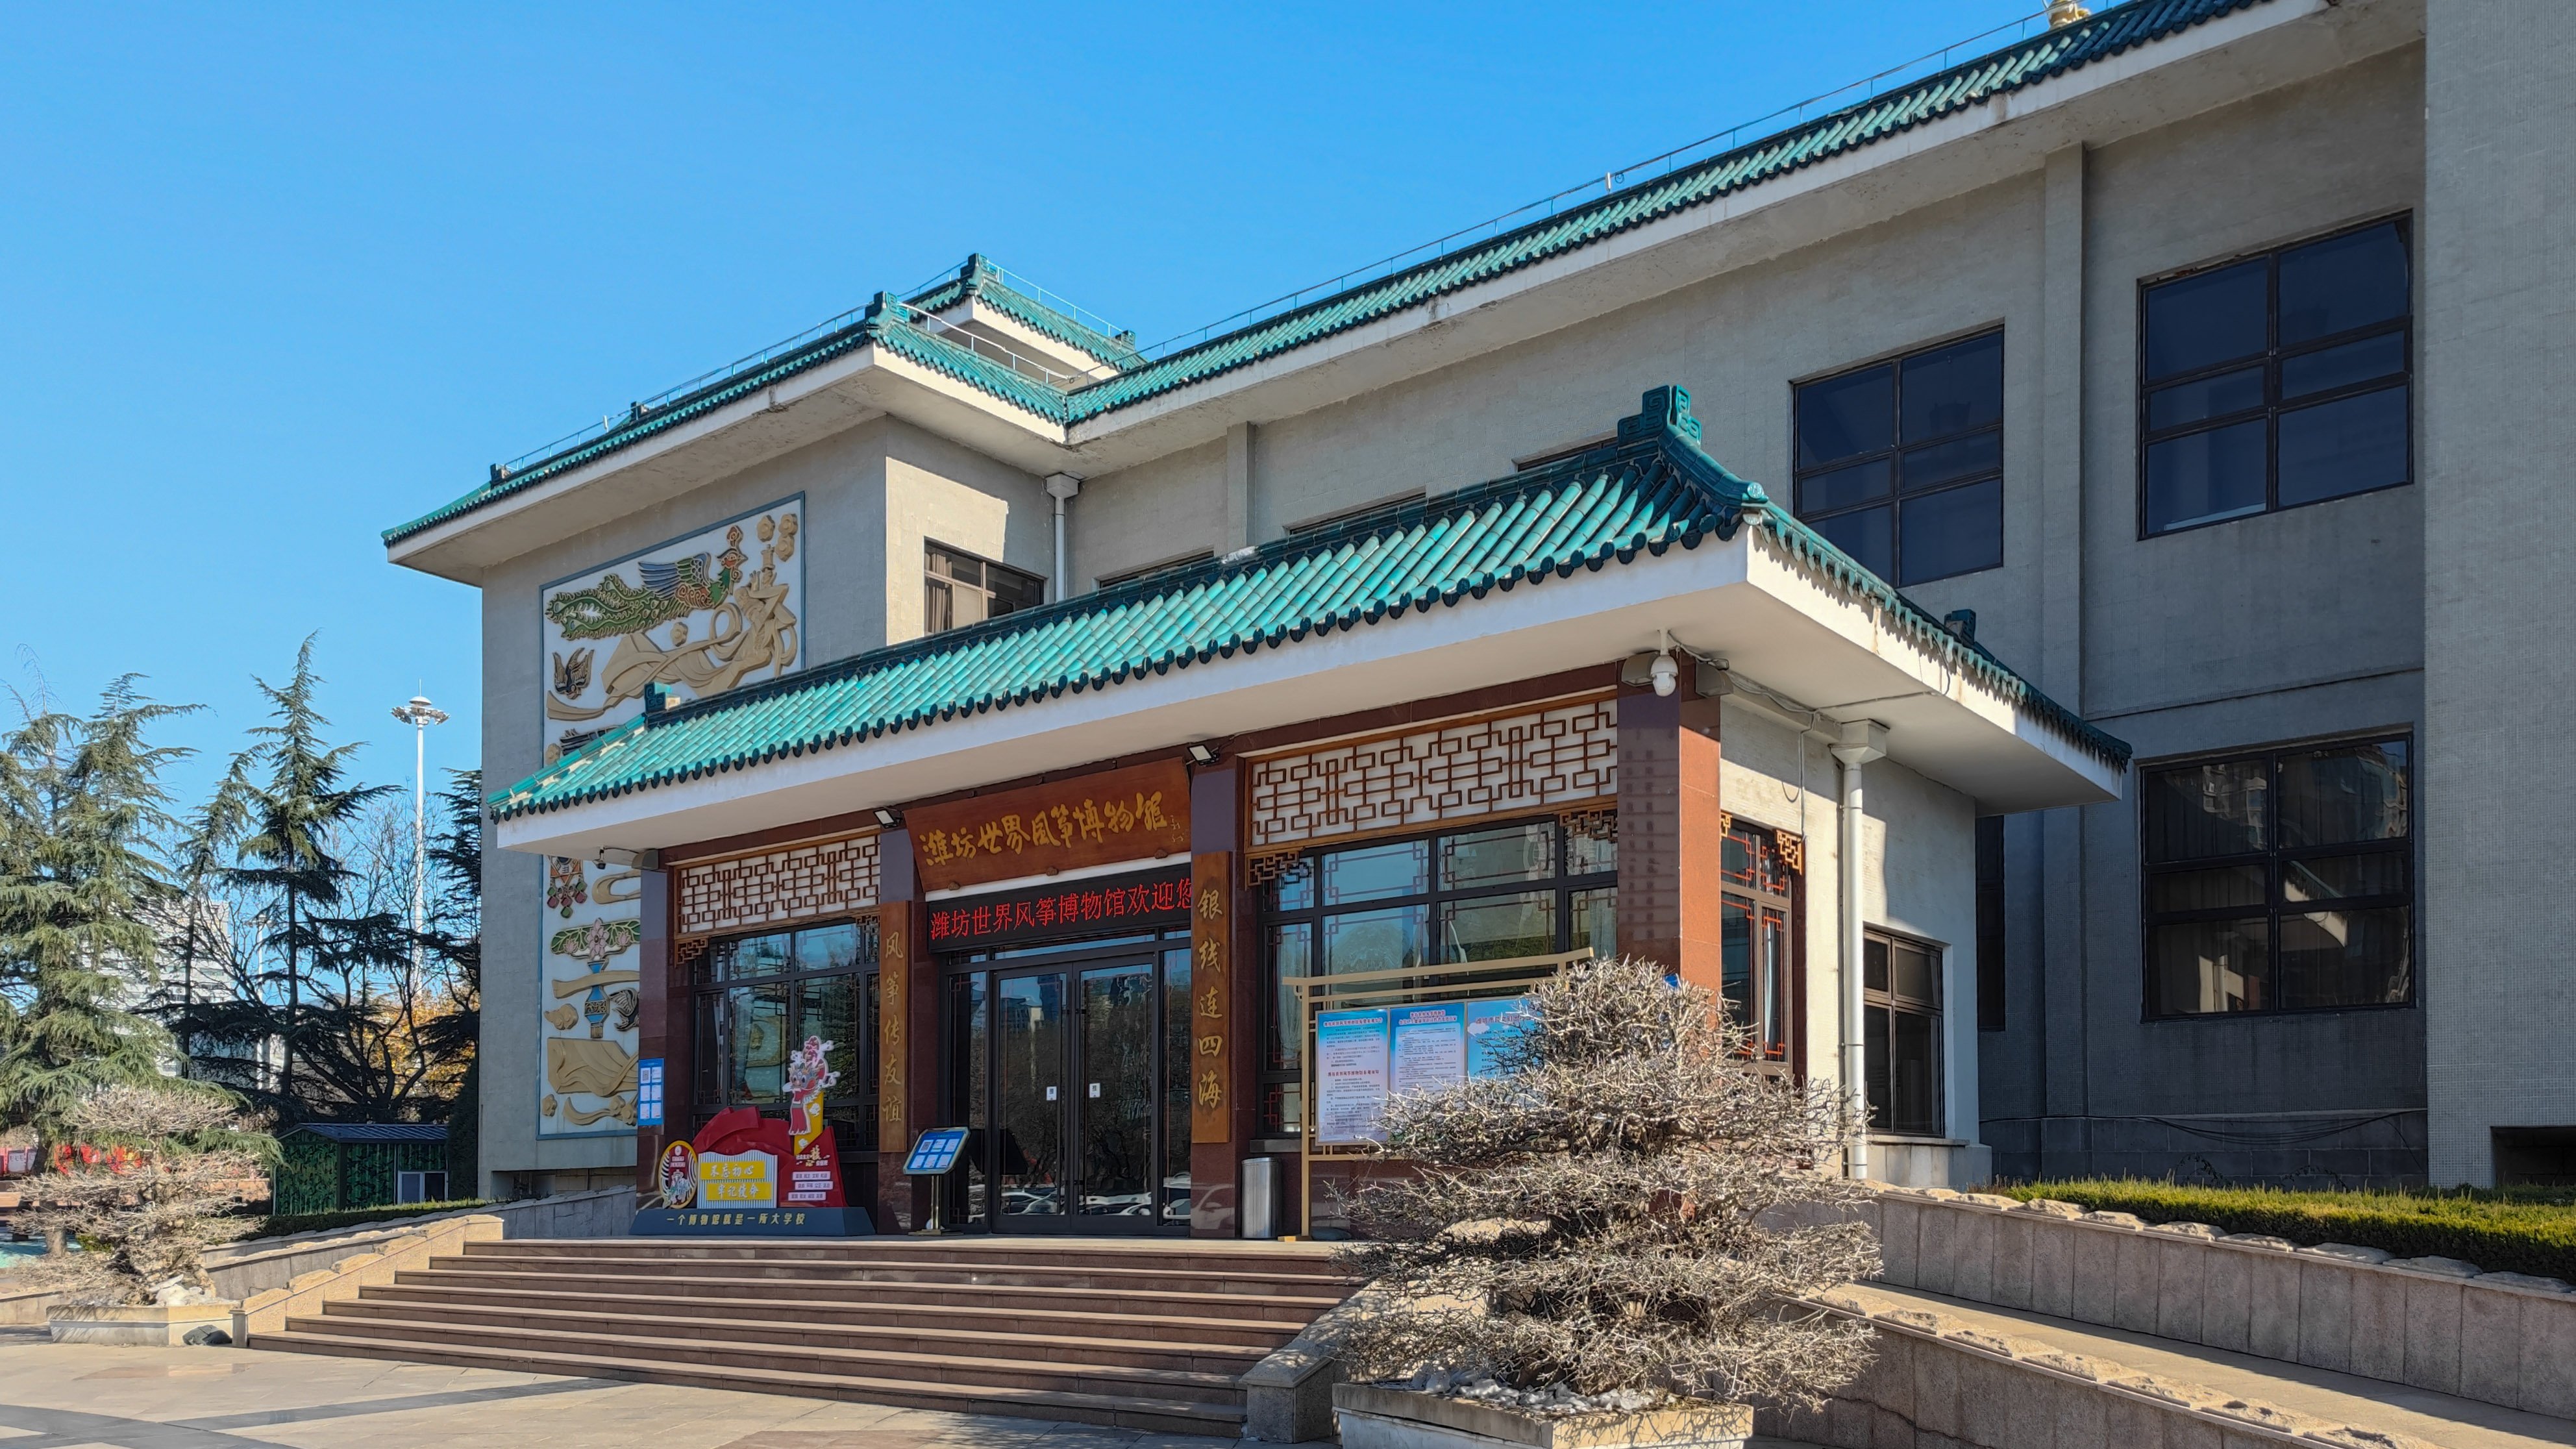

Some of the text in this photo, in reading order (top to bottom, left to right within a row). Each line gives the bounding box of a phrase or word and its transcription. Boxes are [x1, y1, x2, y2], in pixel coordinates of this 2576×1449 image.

[930, 878, 1191, 941] 潍坊世界风筝博物馆欢迎您
[882, 931, 904, 1122] 风筝传友谊
[1197, 889, 1223, 1109] 银线连四海
[666, 1213, 806, 1226] 一个博物馆就是一所大学校
